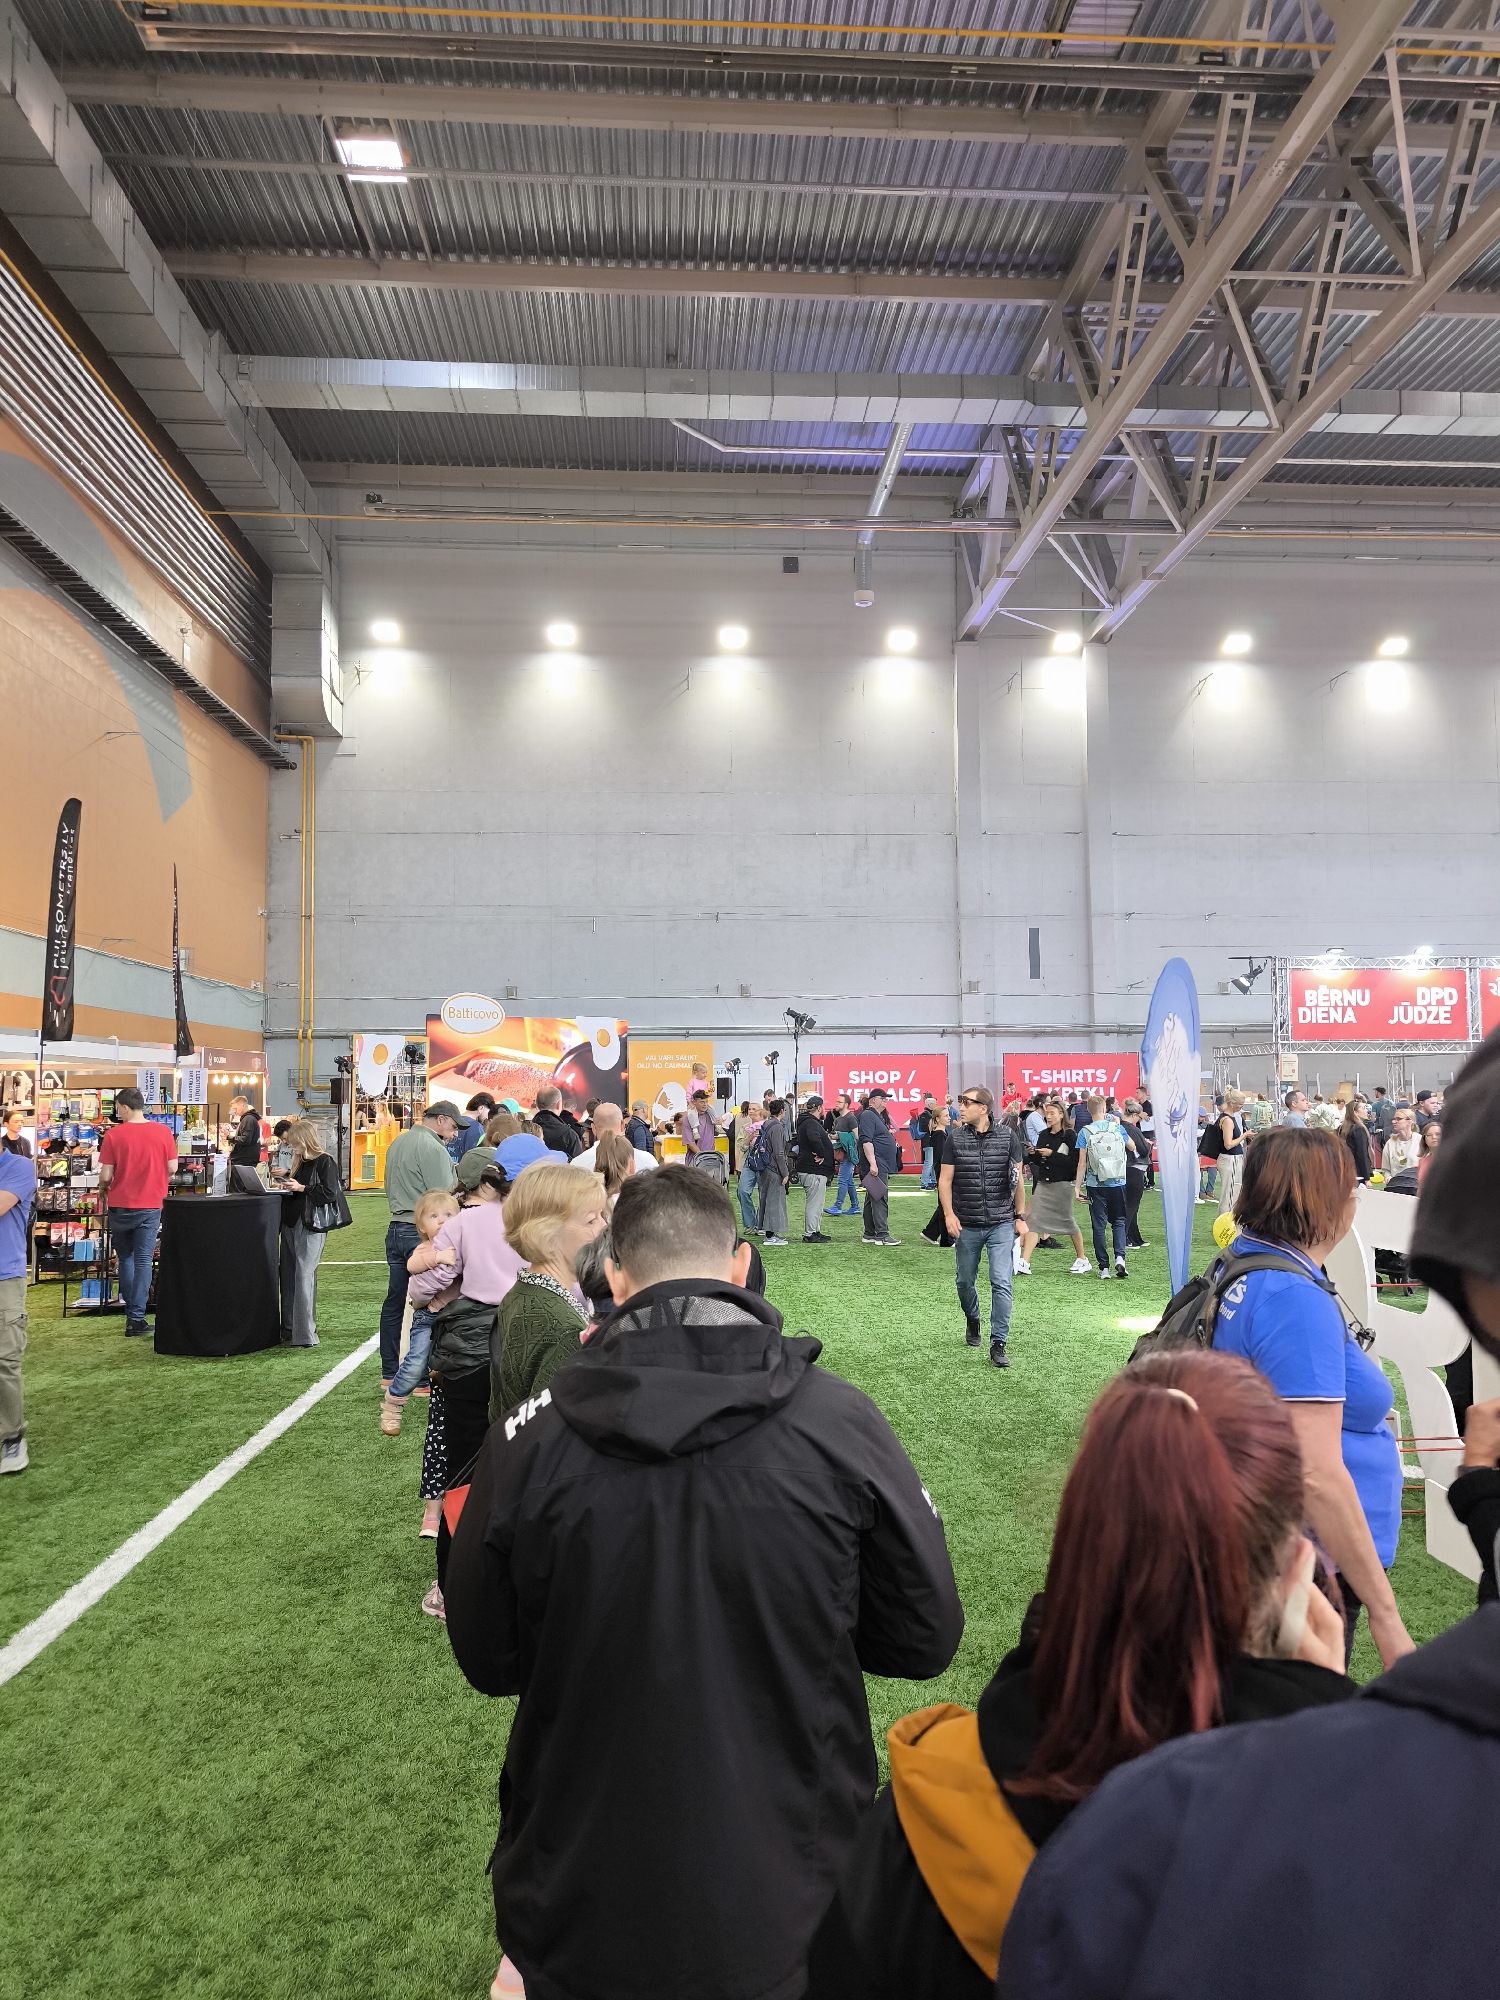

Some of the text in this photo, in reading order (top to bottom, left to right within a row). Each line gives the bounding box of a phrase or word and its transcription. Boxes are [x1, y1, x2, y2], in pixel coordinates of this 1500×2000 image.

[1304, 984, 1371, 1007] BĒRNU
[1416, 986, 1458, 1006] DPD
[447, 1007, 499, 1020] Balticovo
[1297, 1006, 1358, 1024] DIENA
[1387, 1001, 1452, 1025] JŪDZE
[848, 1069, 917, 1085] SHOP /
[1021, 1068, 1122, 1084] T-SHIRTS /
[838, 1088, 922, 1103] VEIALS
